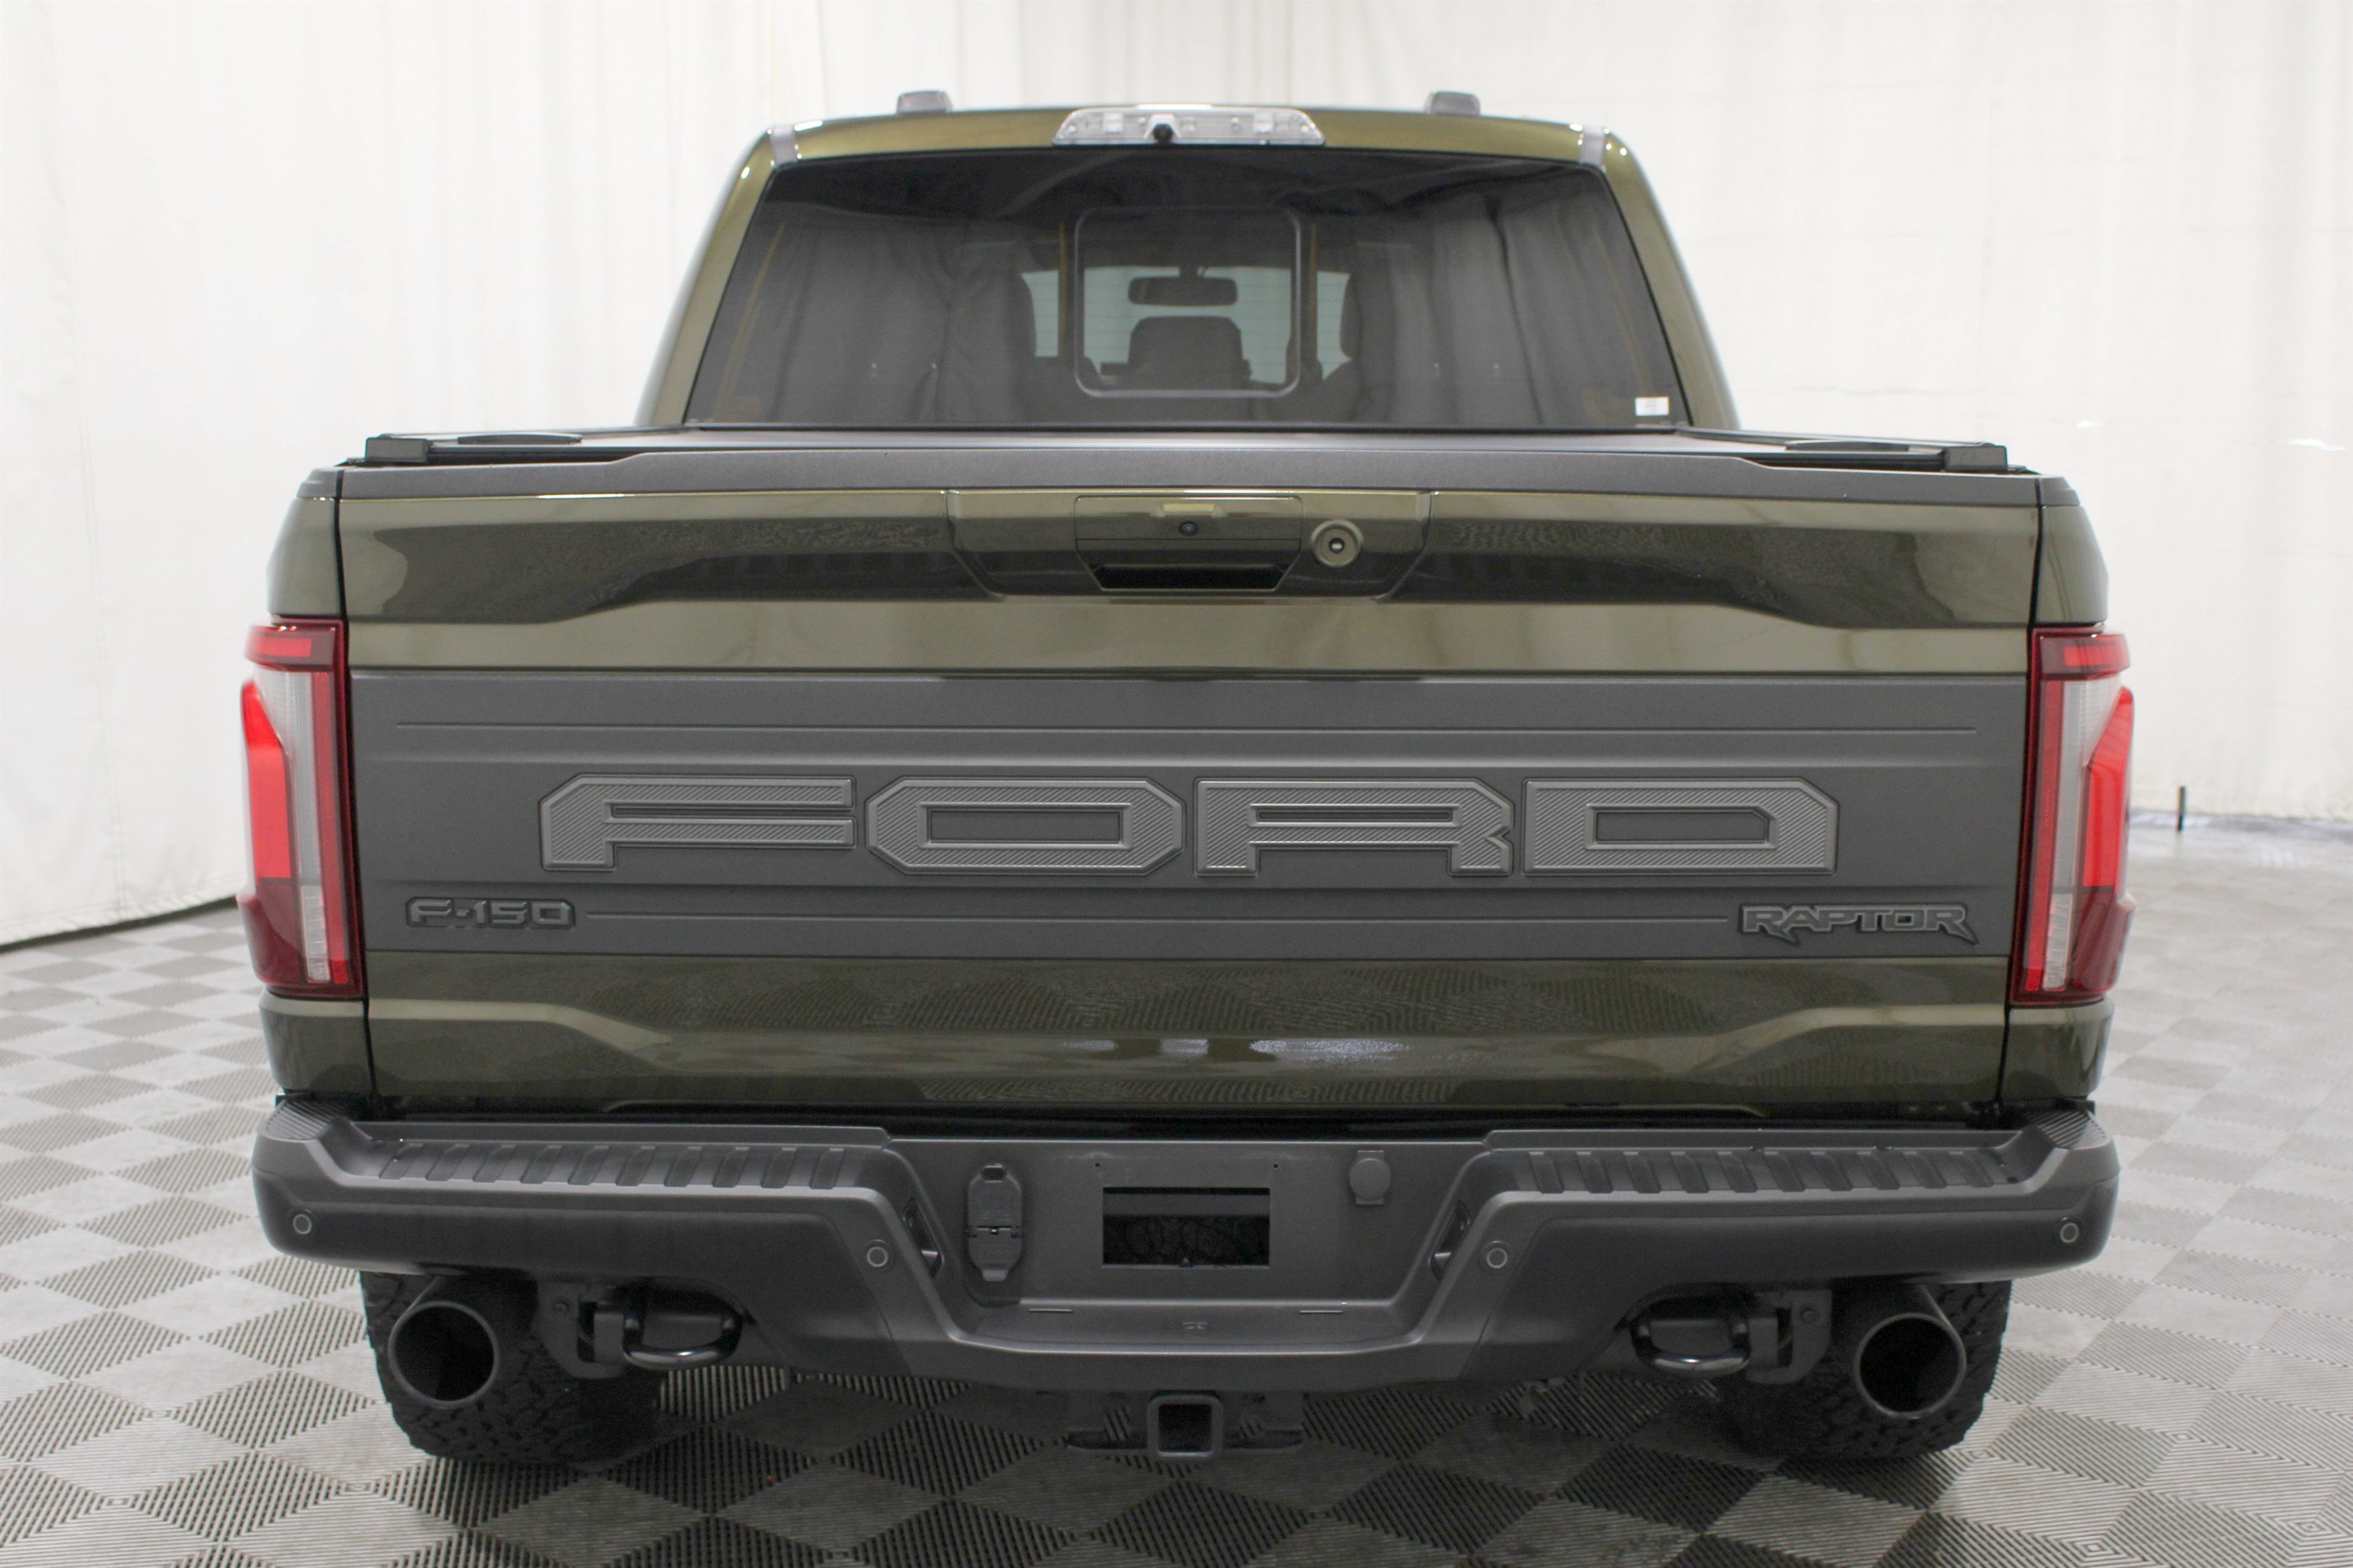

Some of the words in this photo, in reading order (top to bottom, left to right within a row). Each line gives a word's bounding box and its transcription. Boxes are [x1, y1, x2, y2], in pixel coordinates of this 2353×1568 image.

[539, 775, 1839, 875] FORD
[407, 897, 575, 928] F-150
[1741, 904, 1979, 946] RAPTOR
